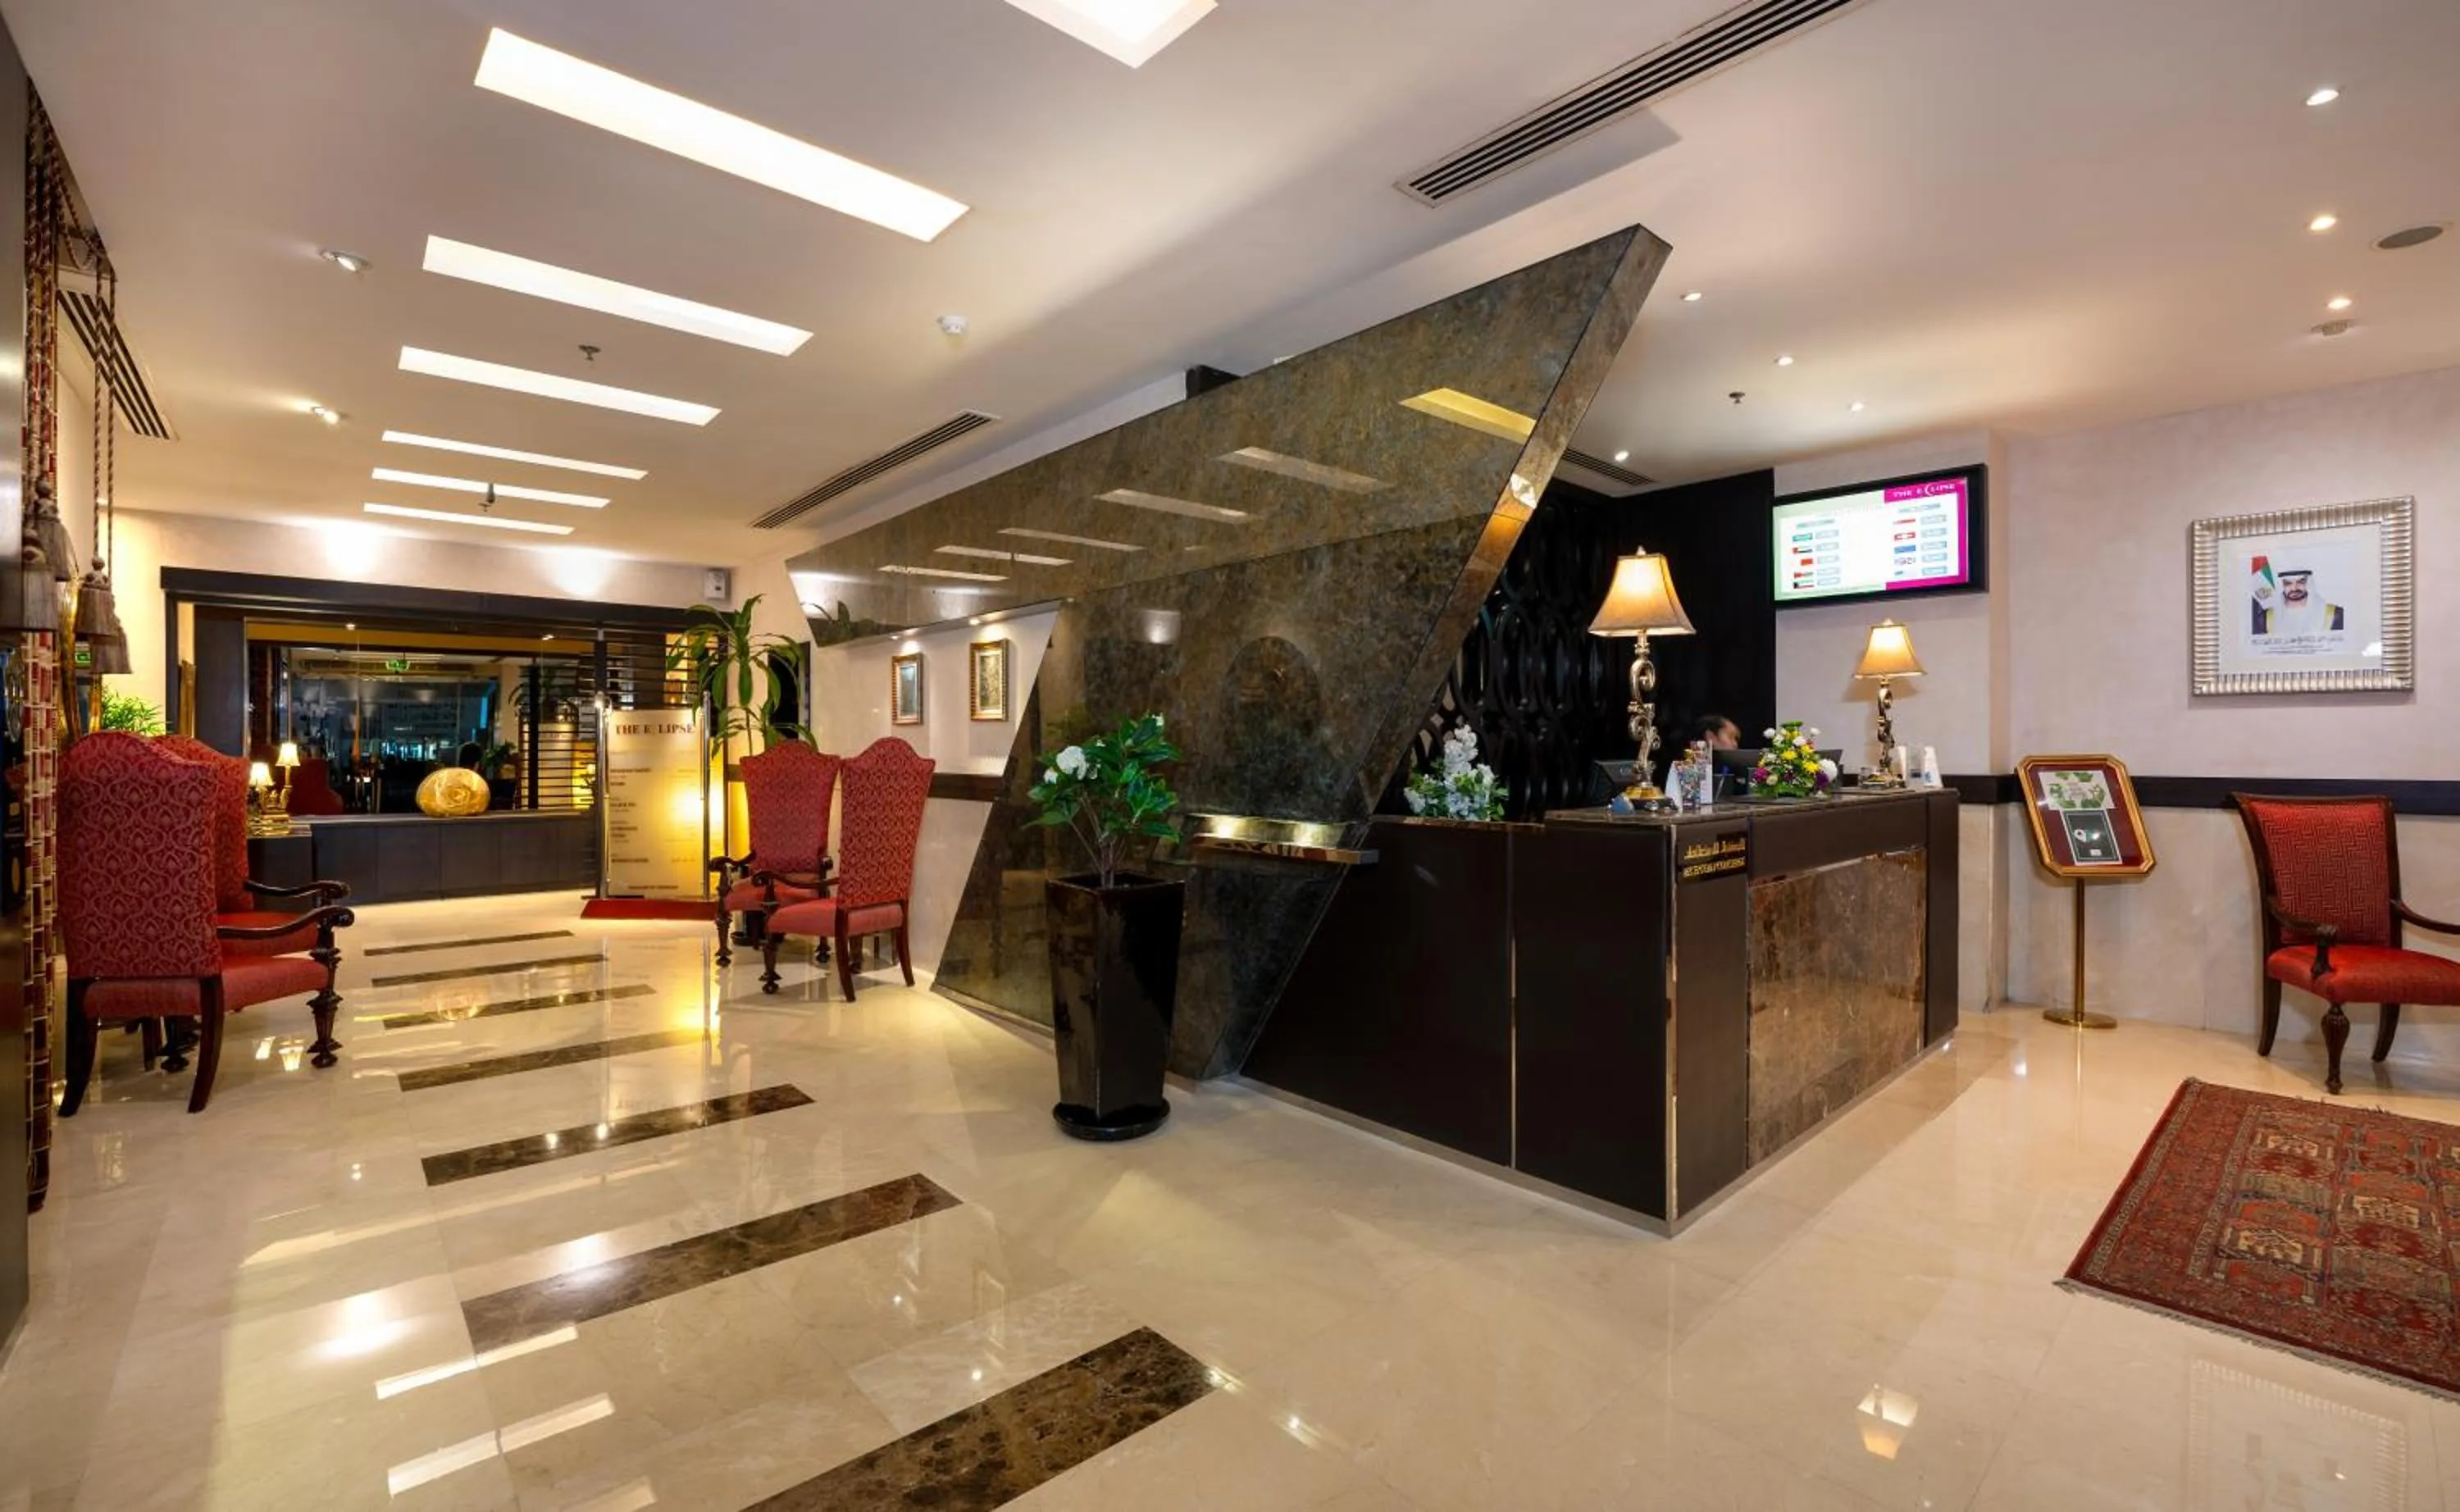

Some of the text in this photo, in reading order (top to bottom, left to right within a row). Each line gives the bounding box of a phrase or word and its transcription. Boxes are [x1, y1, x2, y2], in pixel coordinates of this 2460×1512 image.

[1893, 490, 1912, 498] THE
[616, 724, 695, 736] THE ELIPSE
